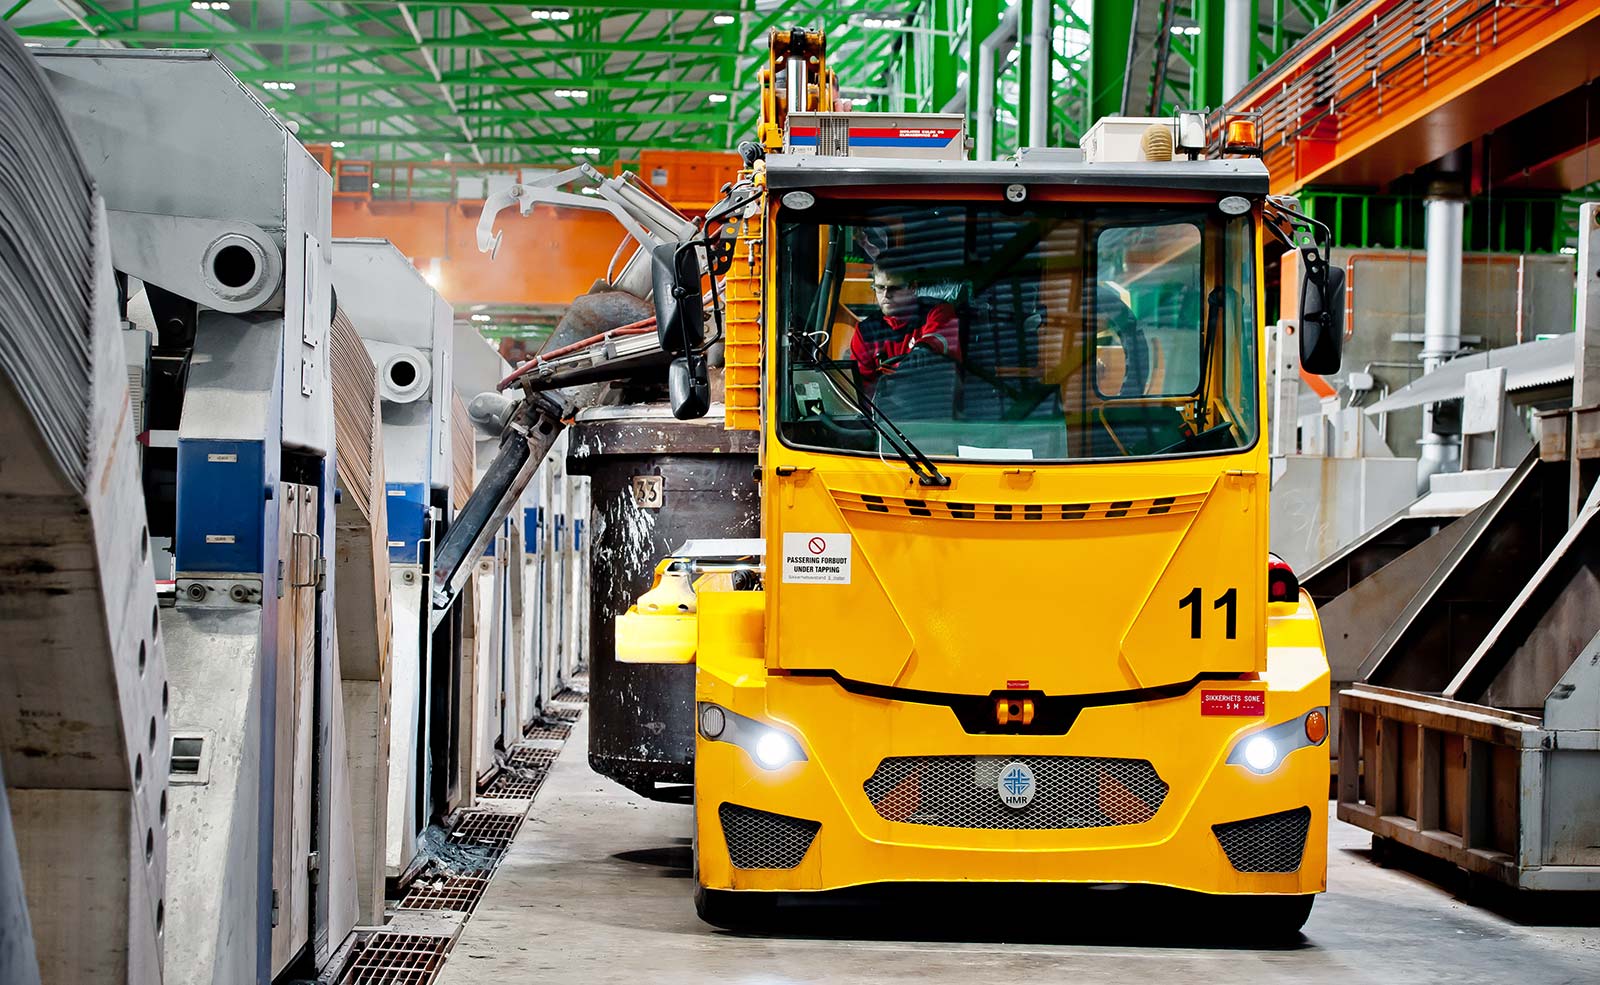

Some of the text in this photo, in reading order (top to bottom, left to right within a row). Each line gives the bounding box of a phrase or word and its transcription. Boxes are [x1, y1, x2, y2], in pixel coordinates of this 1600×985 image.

[637, 480, 657, 502] 33
[787, 556, 820, 564] PASSERING
[793, 565, 840, 574] UNDER TAPPING
[1179, 587, 1237, 640] 11
[1205, 694, 1261, 703] SIKKERHETS SONE
[1005, 796, 1028, 804] HMR
